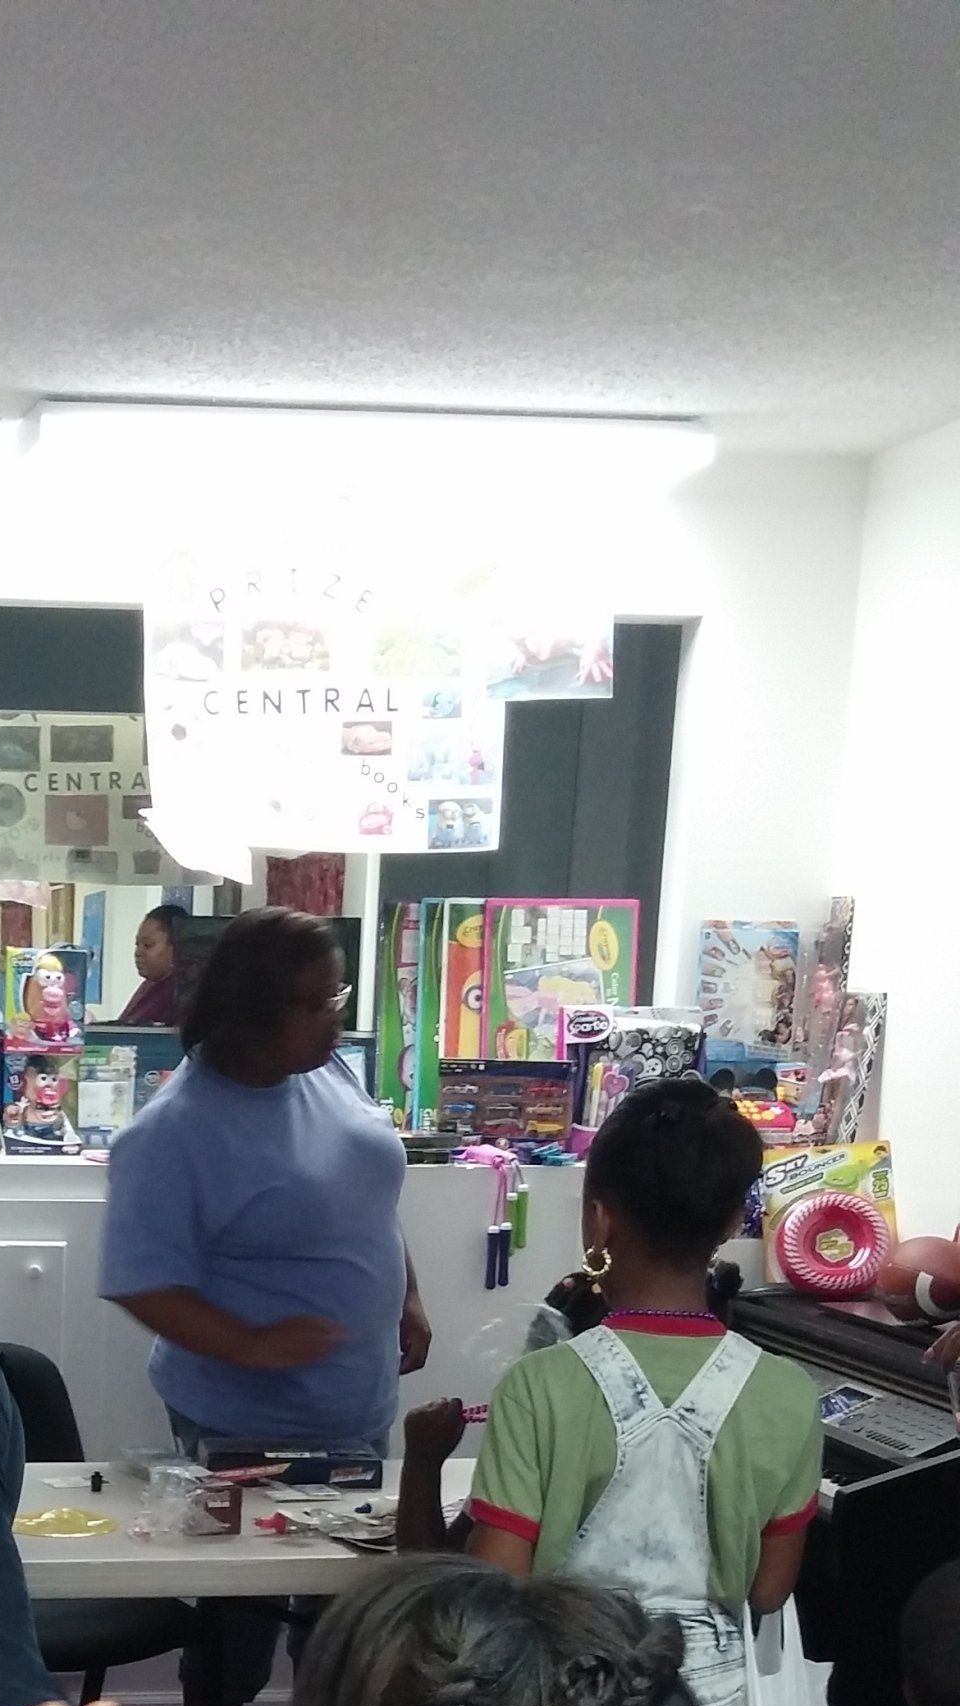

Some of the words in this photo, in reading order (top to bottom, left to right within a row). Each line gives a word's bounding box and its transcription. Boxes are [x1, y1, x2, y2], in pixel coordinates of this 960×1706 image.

[209, 568, 373, 613] PRIZE
[203, 687, 399, 715] CENTRAL
[23, 771, 147, 794] CENTRA
[361, 758, 426, 820] books
[766, 1154, 808, 1188] SKY
[789, 1153, 846, 1181] BOUNCER
